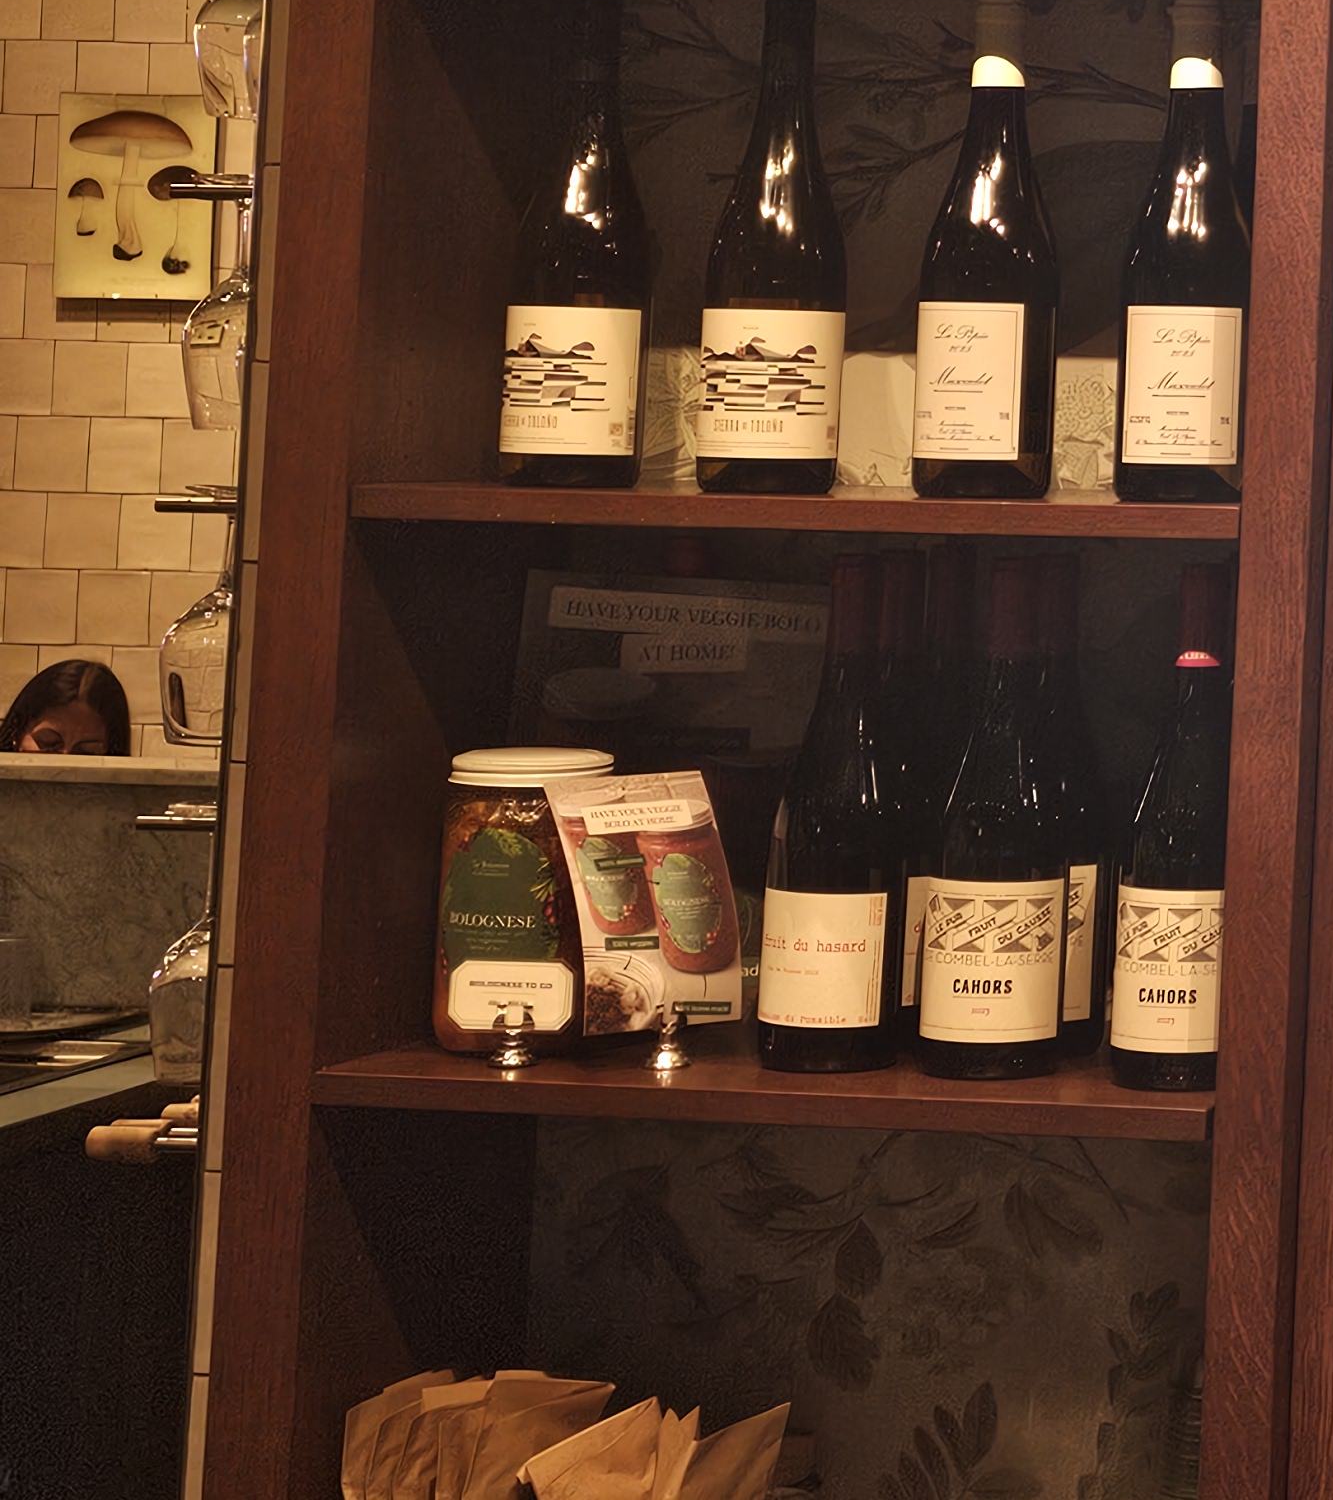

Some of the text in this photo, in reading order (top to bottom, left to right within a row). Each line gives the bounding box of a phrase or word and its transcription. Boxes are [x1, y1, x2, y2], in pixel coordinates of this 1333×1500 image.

[968, 916, 997, 937] FRUIT
[793, 937, 808, 952] du
[816, 939, 866, 953] hasard
[952, 978, 1013, 995] CAHORS
[1138, 987, 1198, 1005] CAHORS
